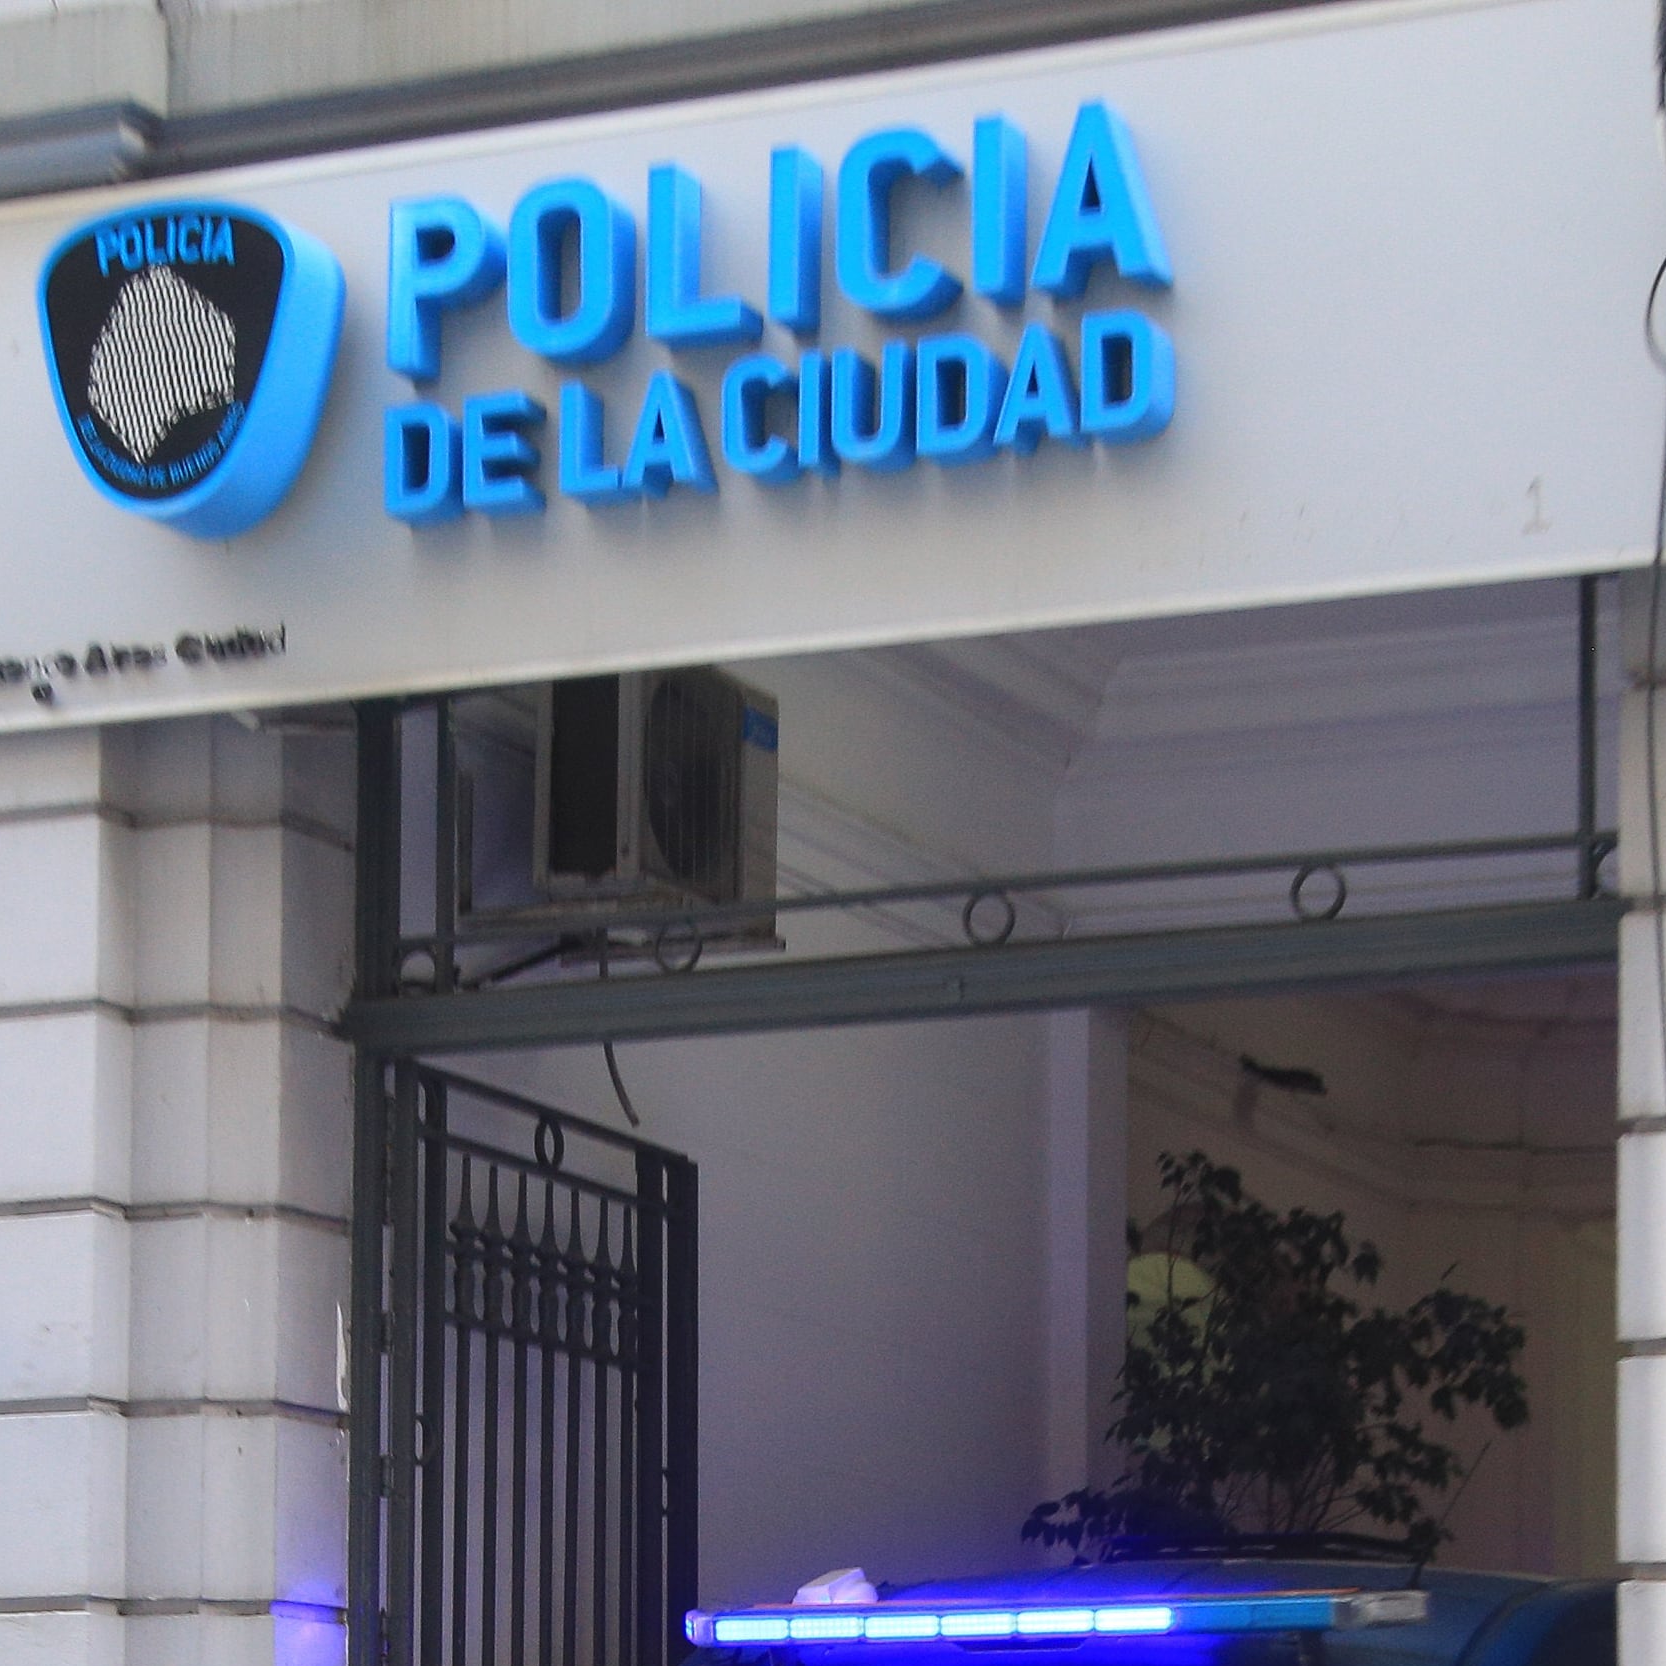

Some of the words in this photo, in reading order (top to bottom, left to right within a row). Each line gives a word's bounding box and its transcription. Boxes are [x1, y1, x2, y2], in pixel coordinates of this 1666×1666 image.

[95, 214, 234, 278] POLICIA
[387, 99, 1173, 379] POLICIA
[384, 390, 545, 524] DE
[559, 370, 718, 504] LA
[722, 308, 1175, 482] CIUDAD
